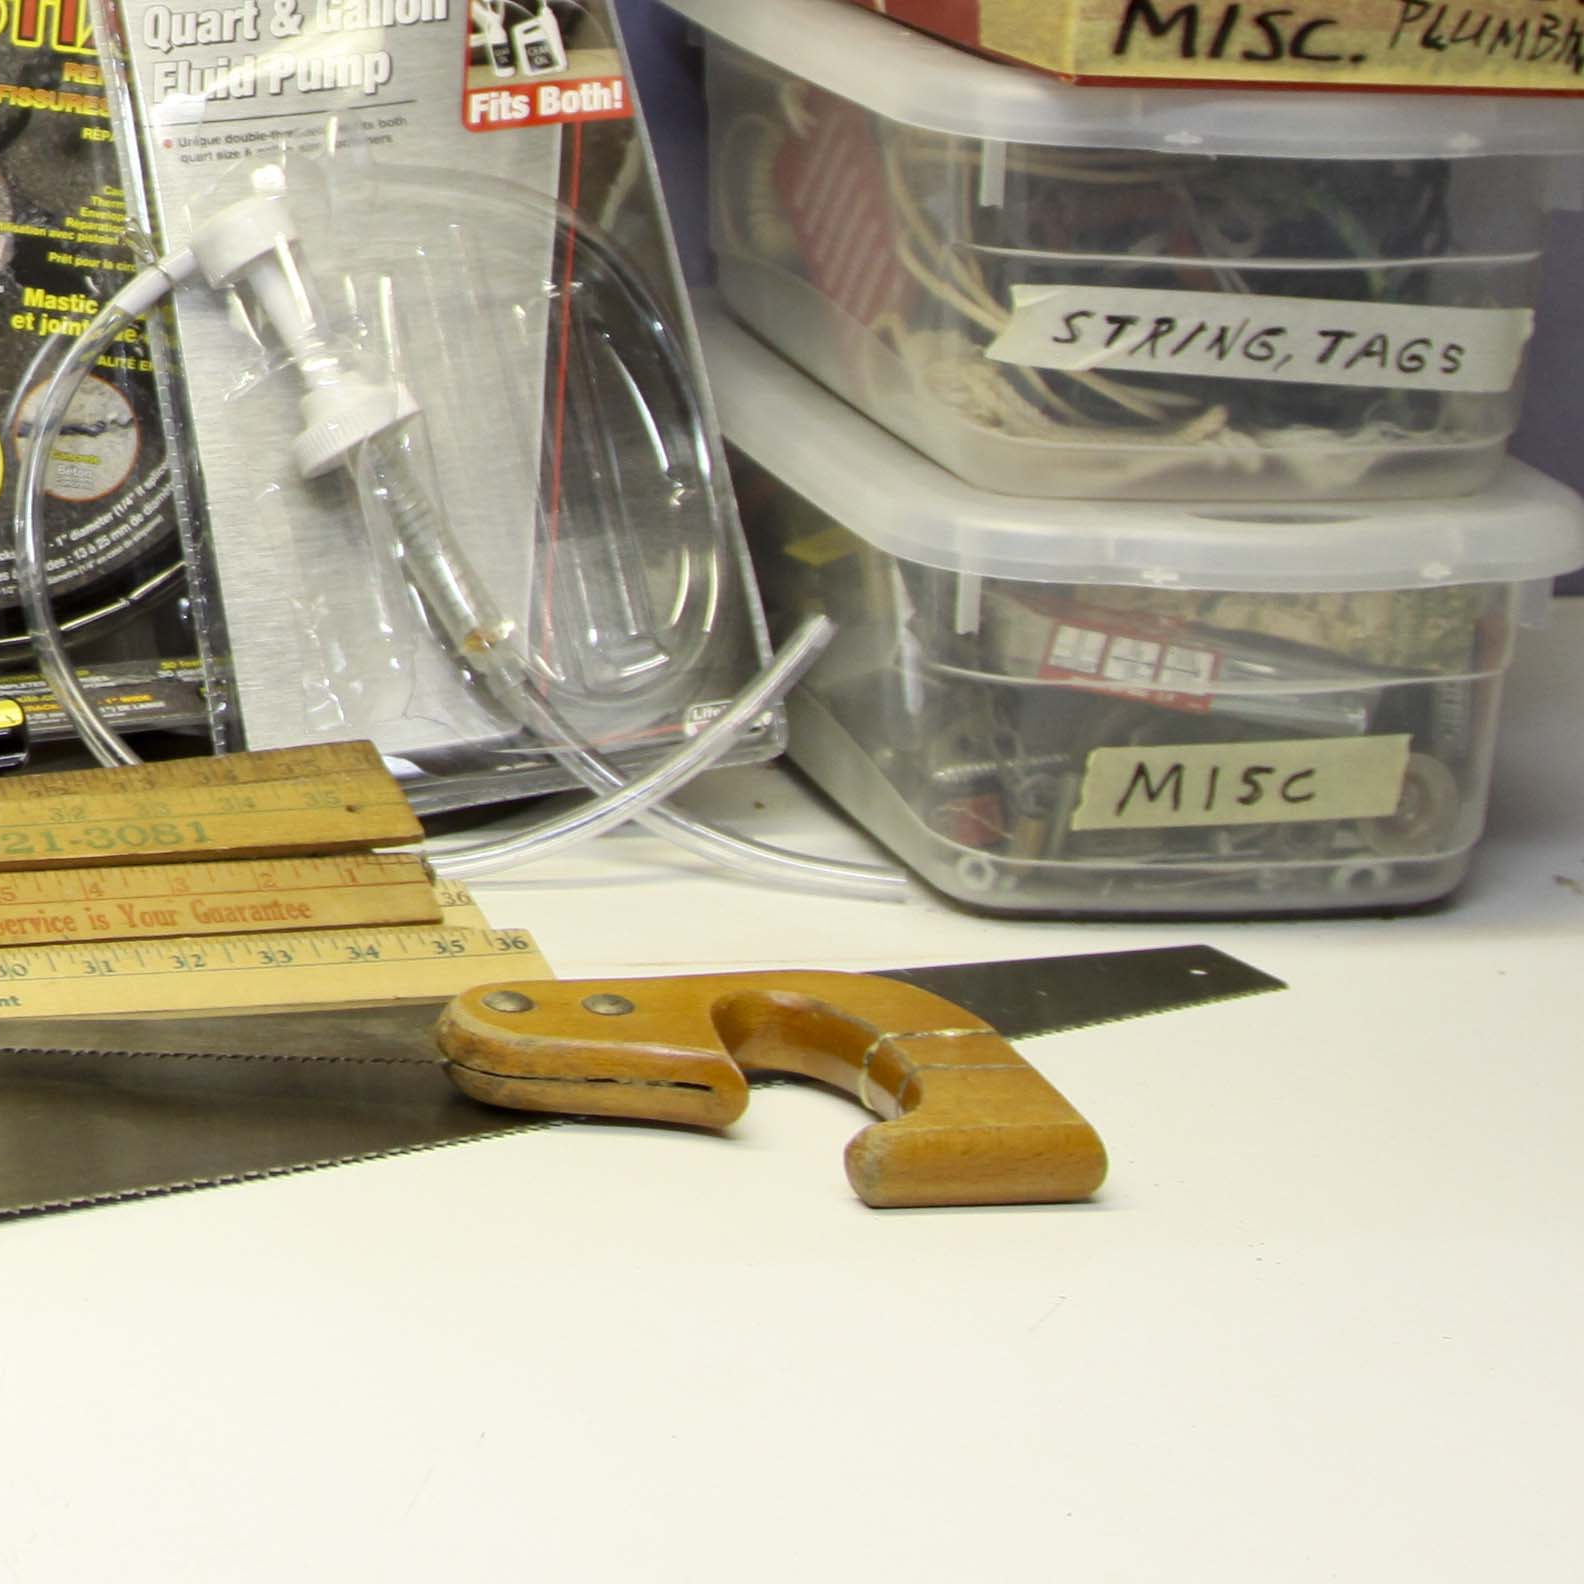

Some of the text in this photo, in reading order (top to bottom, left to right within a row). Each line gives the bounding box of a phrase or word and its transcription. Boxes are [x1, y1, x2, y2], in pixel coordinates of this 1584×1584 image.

[151, 48, 392, 104] Fluid Pump
[468, 79, 624, 125] Fits Both!
[23, 287, 99, 314] Mastic
[1051, 309, 1467, 377] STRING, TAGS
[1115, 764, 1319, 815] MISC
[85, 906, 111, 933] is
[117, 900, 183, 932] Your
[191, 897, 314, 927] Guarantee
